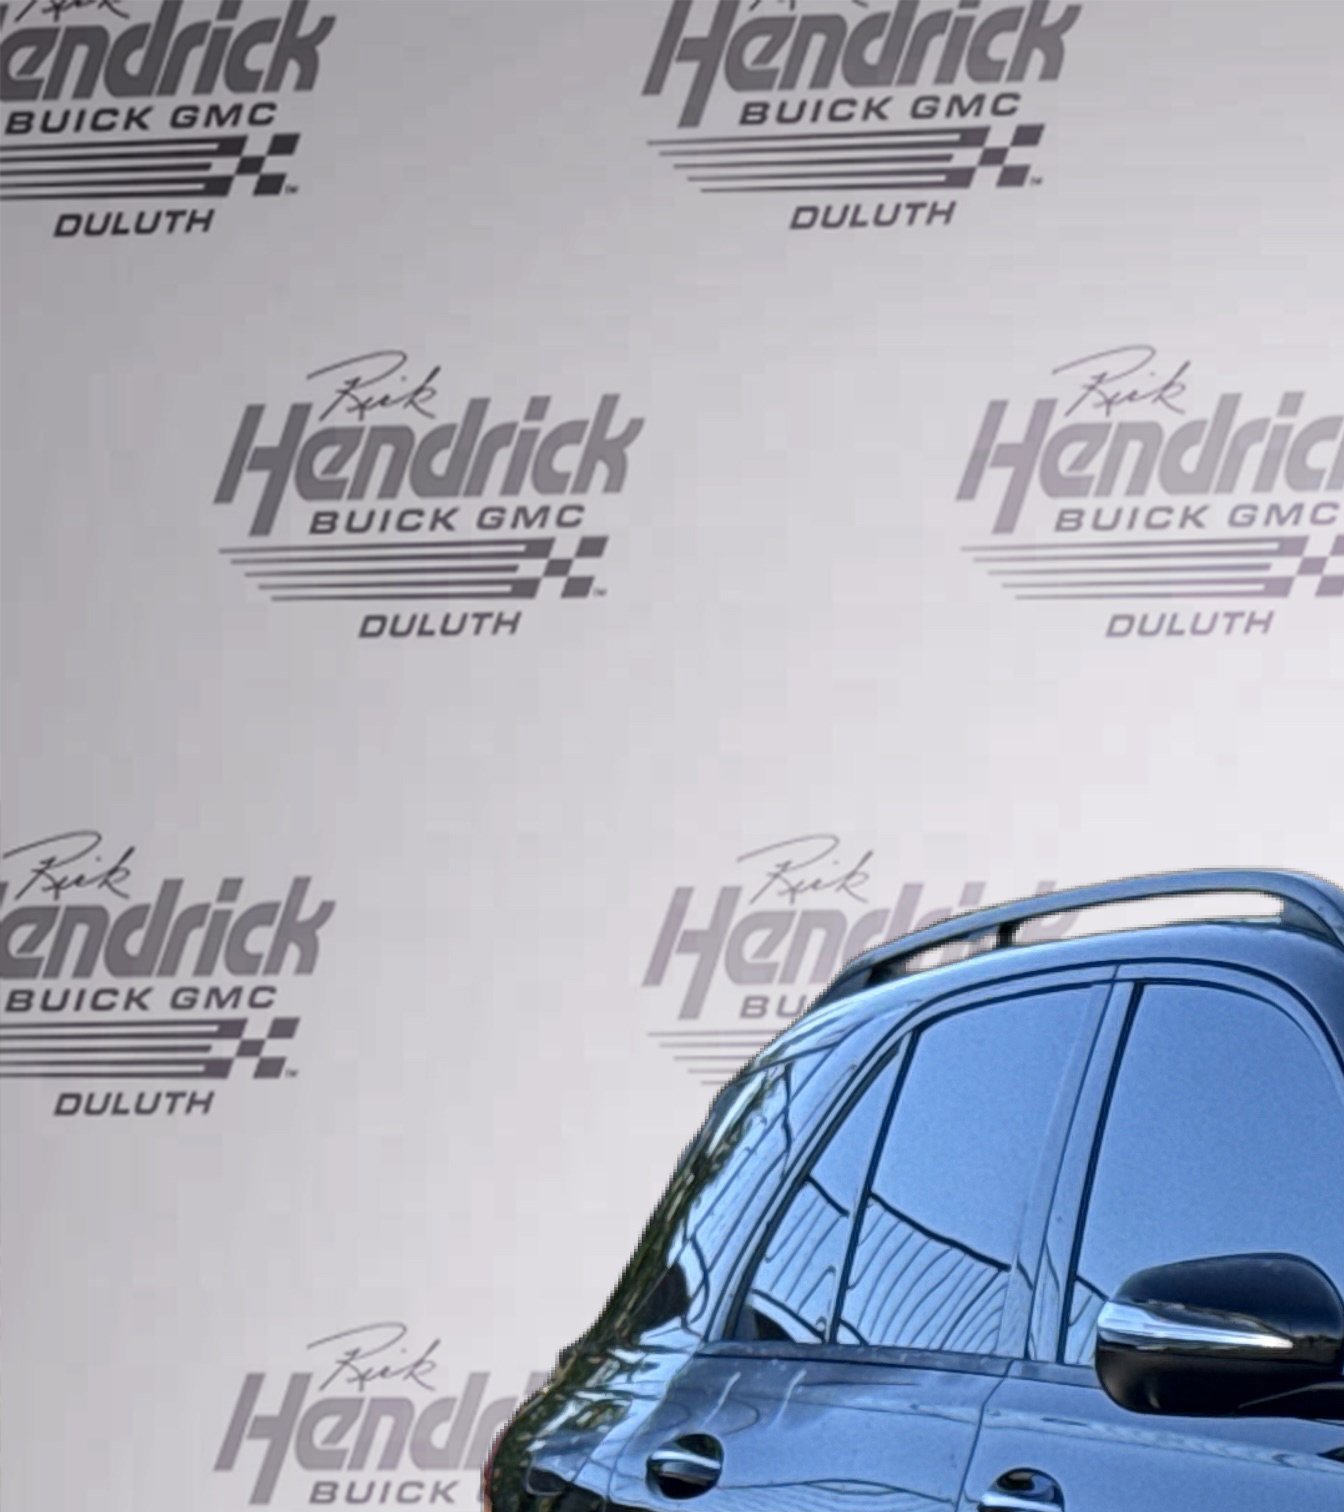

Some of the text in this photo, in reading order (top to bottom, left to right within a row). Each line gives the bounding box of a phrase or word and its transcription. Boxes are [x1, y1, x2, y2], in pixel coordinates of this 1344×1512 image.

[0, 0, 336, 101] endrick
[641, 0, 1082, 128] Hendrick
[5, 102, 277, 135] BUICK GMC
[739, 92, 1021, 126] BUICK GMC
[54, 209, 215, 237] DULUTH
[790, 201, 956, 230] DULUTH
[214, 394, 644, 535] Hendrick
[309, 504, 585, 534] BUICK GMC
[1054, 502, 1340, 532] BUICK GMC
[359, 611, 522, 638] DULUTH
[1106, 611, 1274, 638] DULUTH
[0, 876, 336, 980] endrick
[5, 986, 277, 1012] BUICK GMC
[54, 1091, 214, 1116] DULUTH
[213, 1371, 552, 1505] Hendr
[309, 1481, 458, 1505] BUICK
